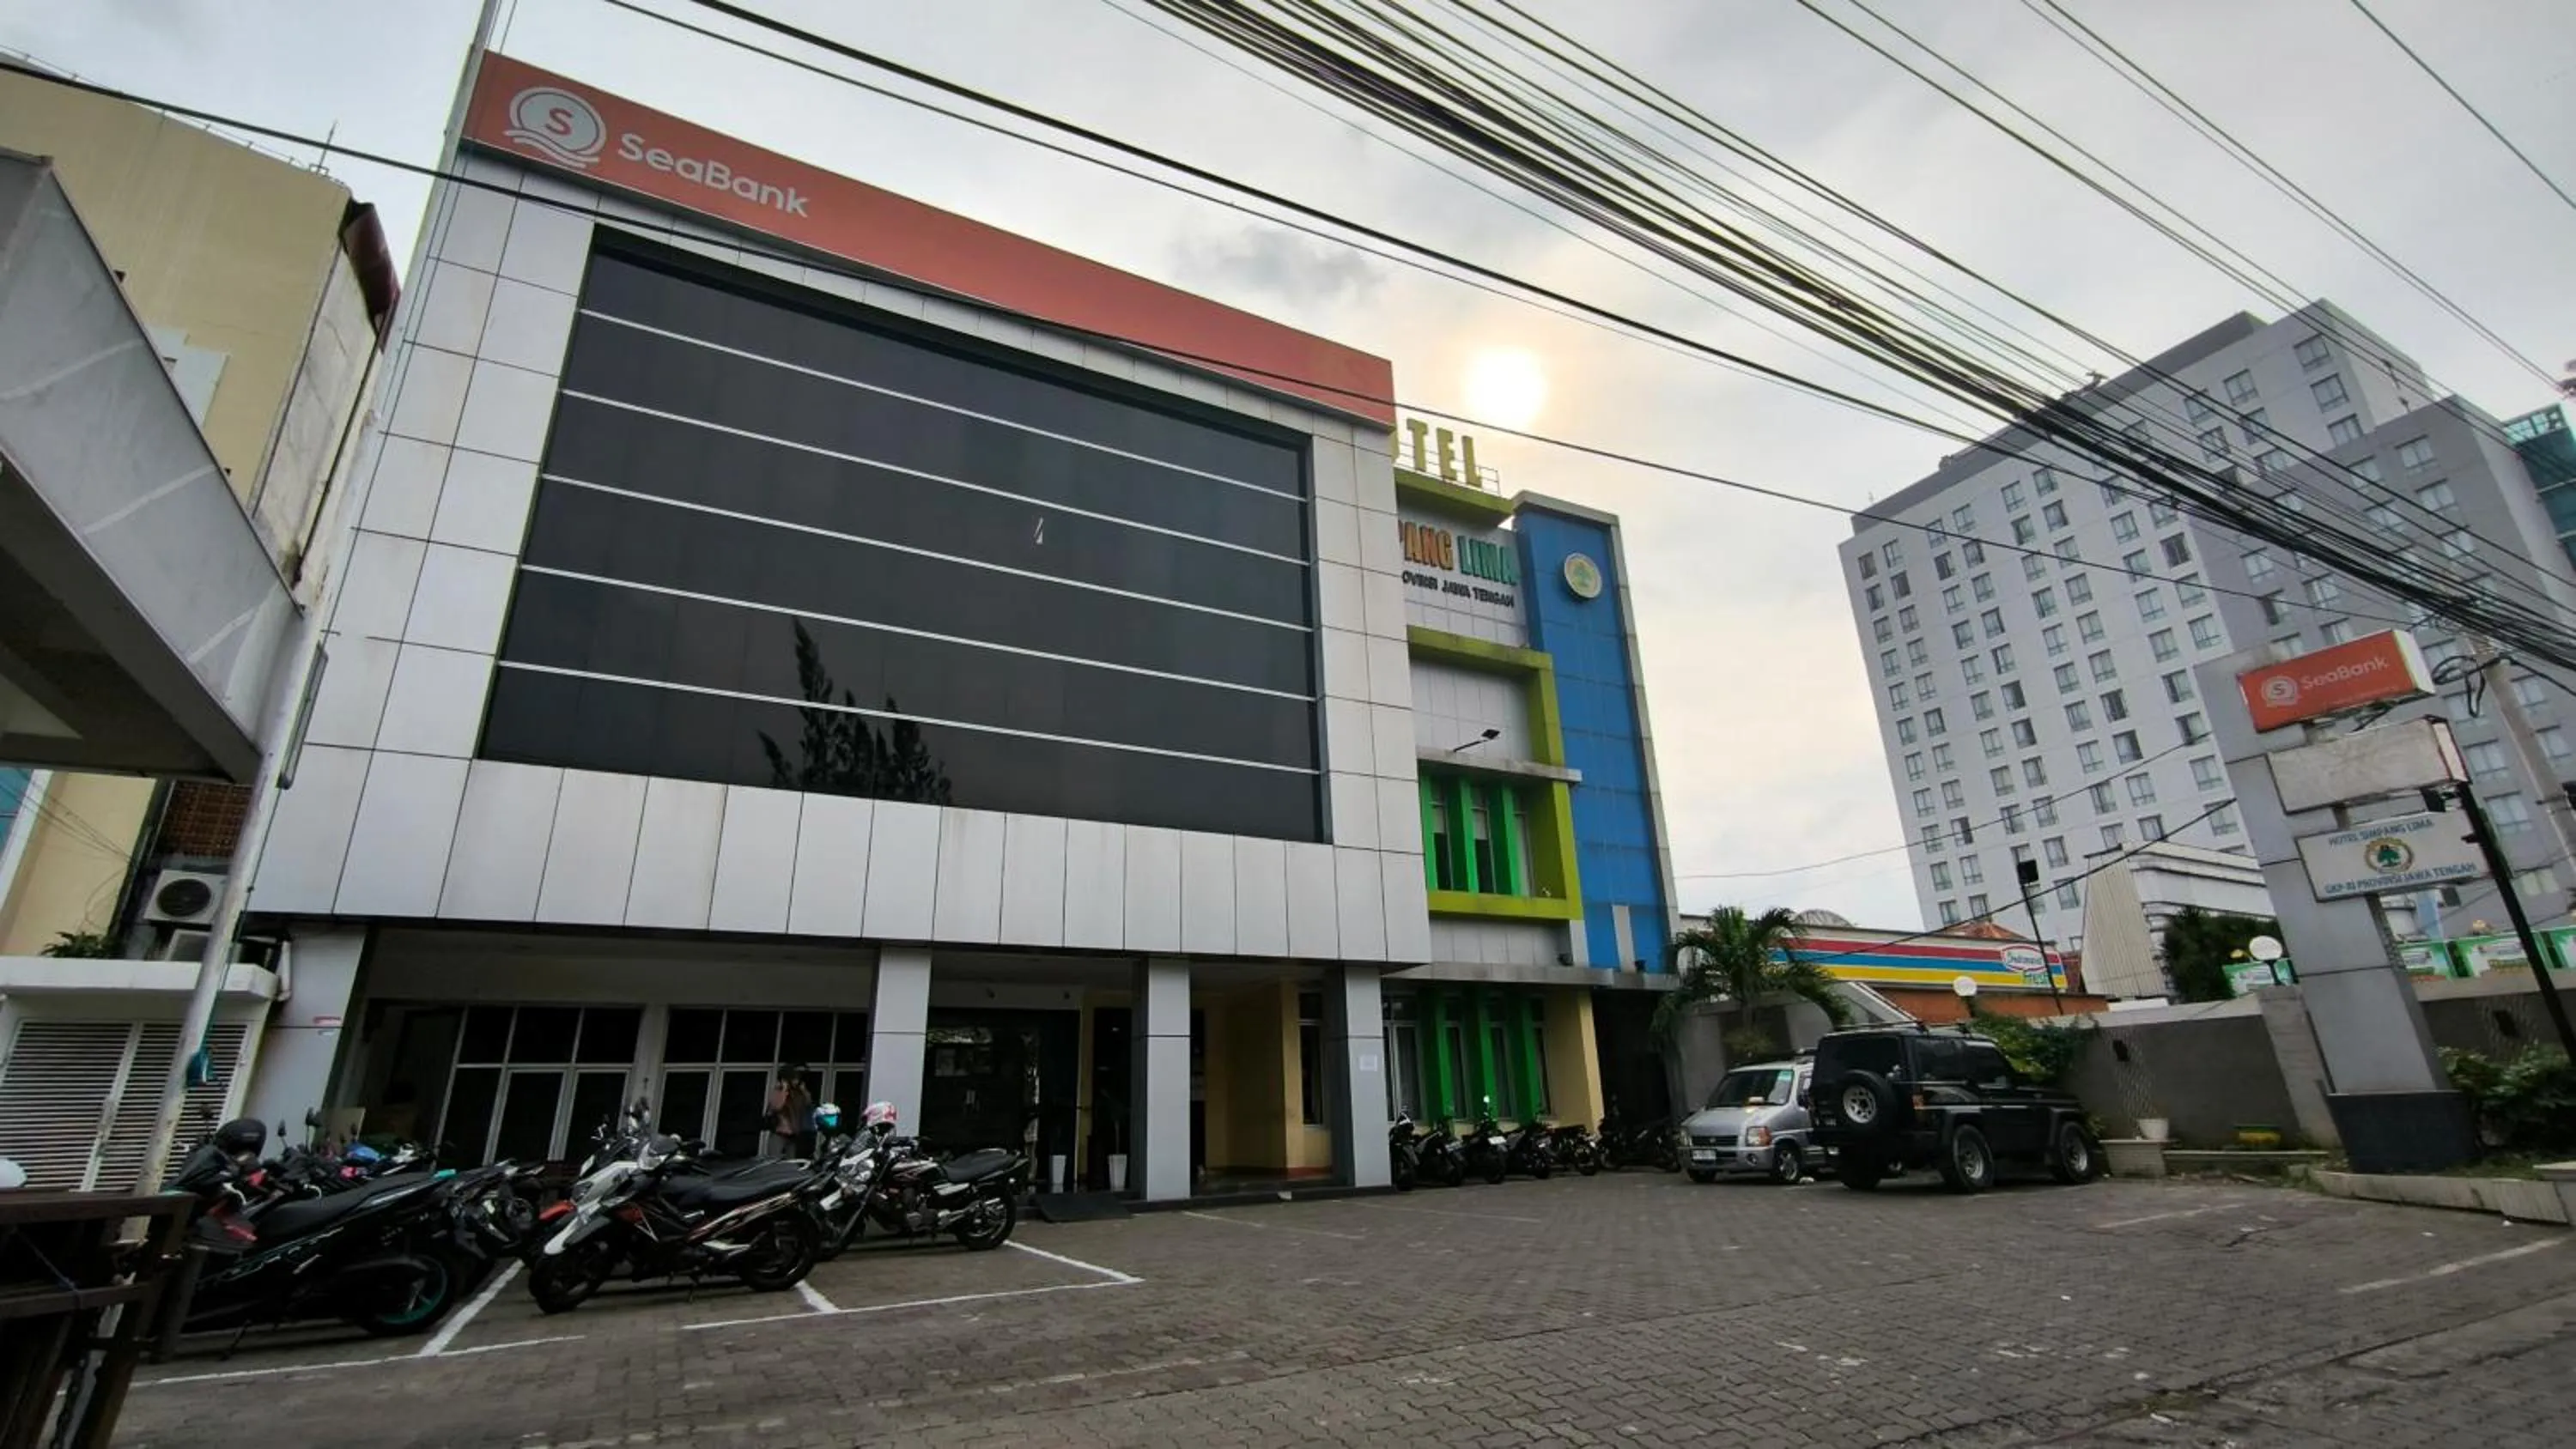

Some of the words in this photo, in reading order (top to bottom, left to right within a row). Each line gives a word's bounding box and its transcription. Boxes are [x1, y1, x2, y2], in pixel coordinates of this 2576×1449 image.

[545, 107, 573, 136] S
[618, 132, 810, 218] SeaBank
[1388, 418, 1482, 488] TEL
[1398, 518, 1454, 570] ANG
[1457, 535, 1518, 586] LIMA
[1442, 579, 1471, 598] JAWA
[1472, 587, 1514, 607] TENGAH
[2300, 656, 2390, 689] SeaBank
[2329, 833, 2359, 846] HOTEL
[2360, 824, 2407, 840] SIMPANG
[2408, 818, 2434, 831] LIMA
[2403, 870, 2433, 882] JAWA
[2433, 862, 2477, 878] TENGAH
